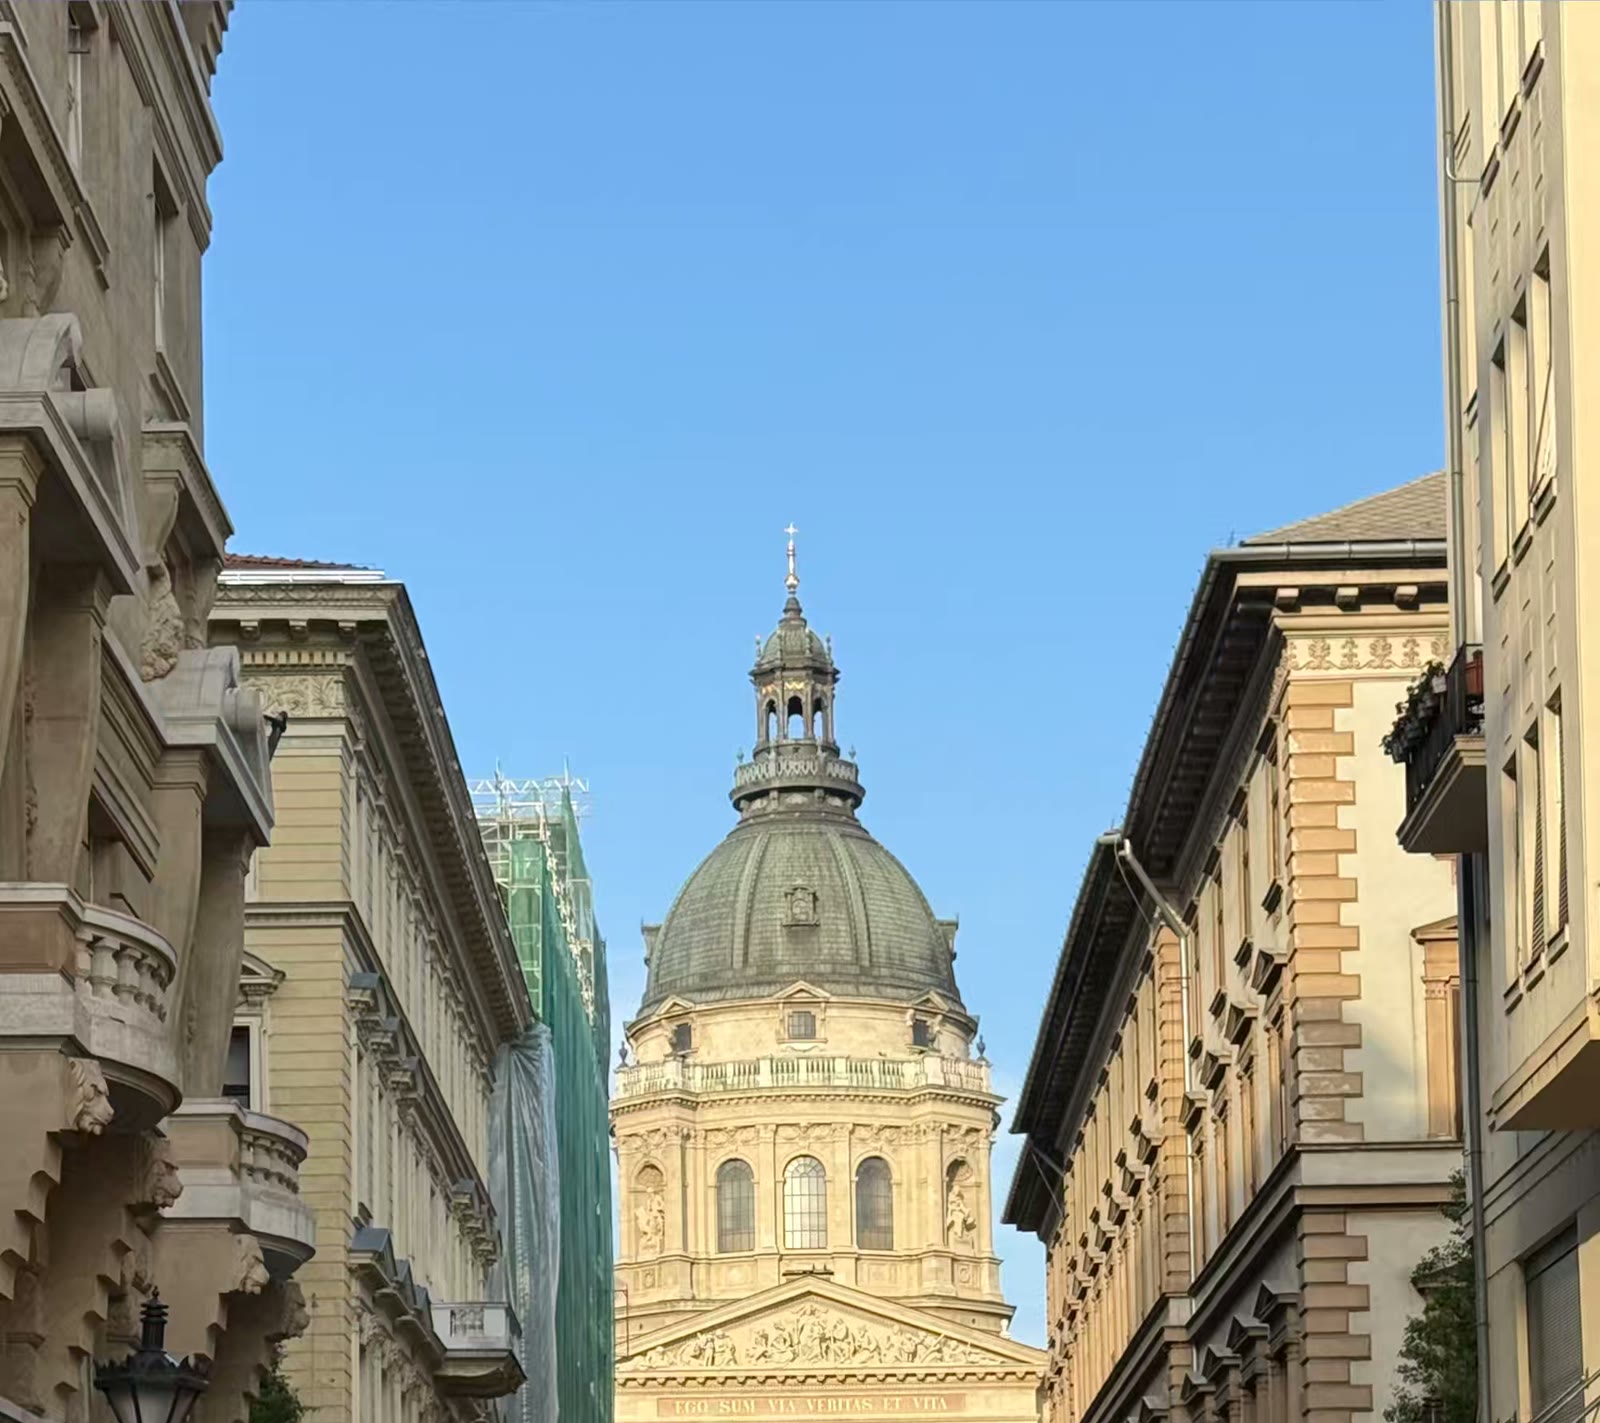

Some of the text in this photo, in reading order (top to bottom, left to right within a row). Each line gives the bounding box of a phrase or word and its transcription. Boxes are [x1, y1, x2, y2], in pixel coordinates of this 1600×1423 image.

[674, 1396, 948, 1415] EGO SUM VIA VERITAS ET VITA
